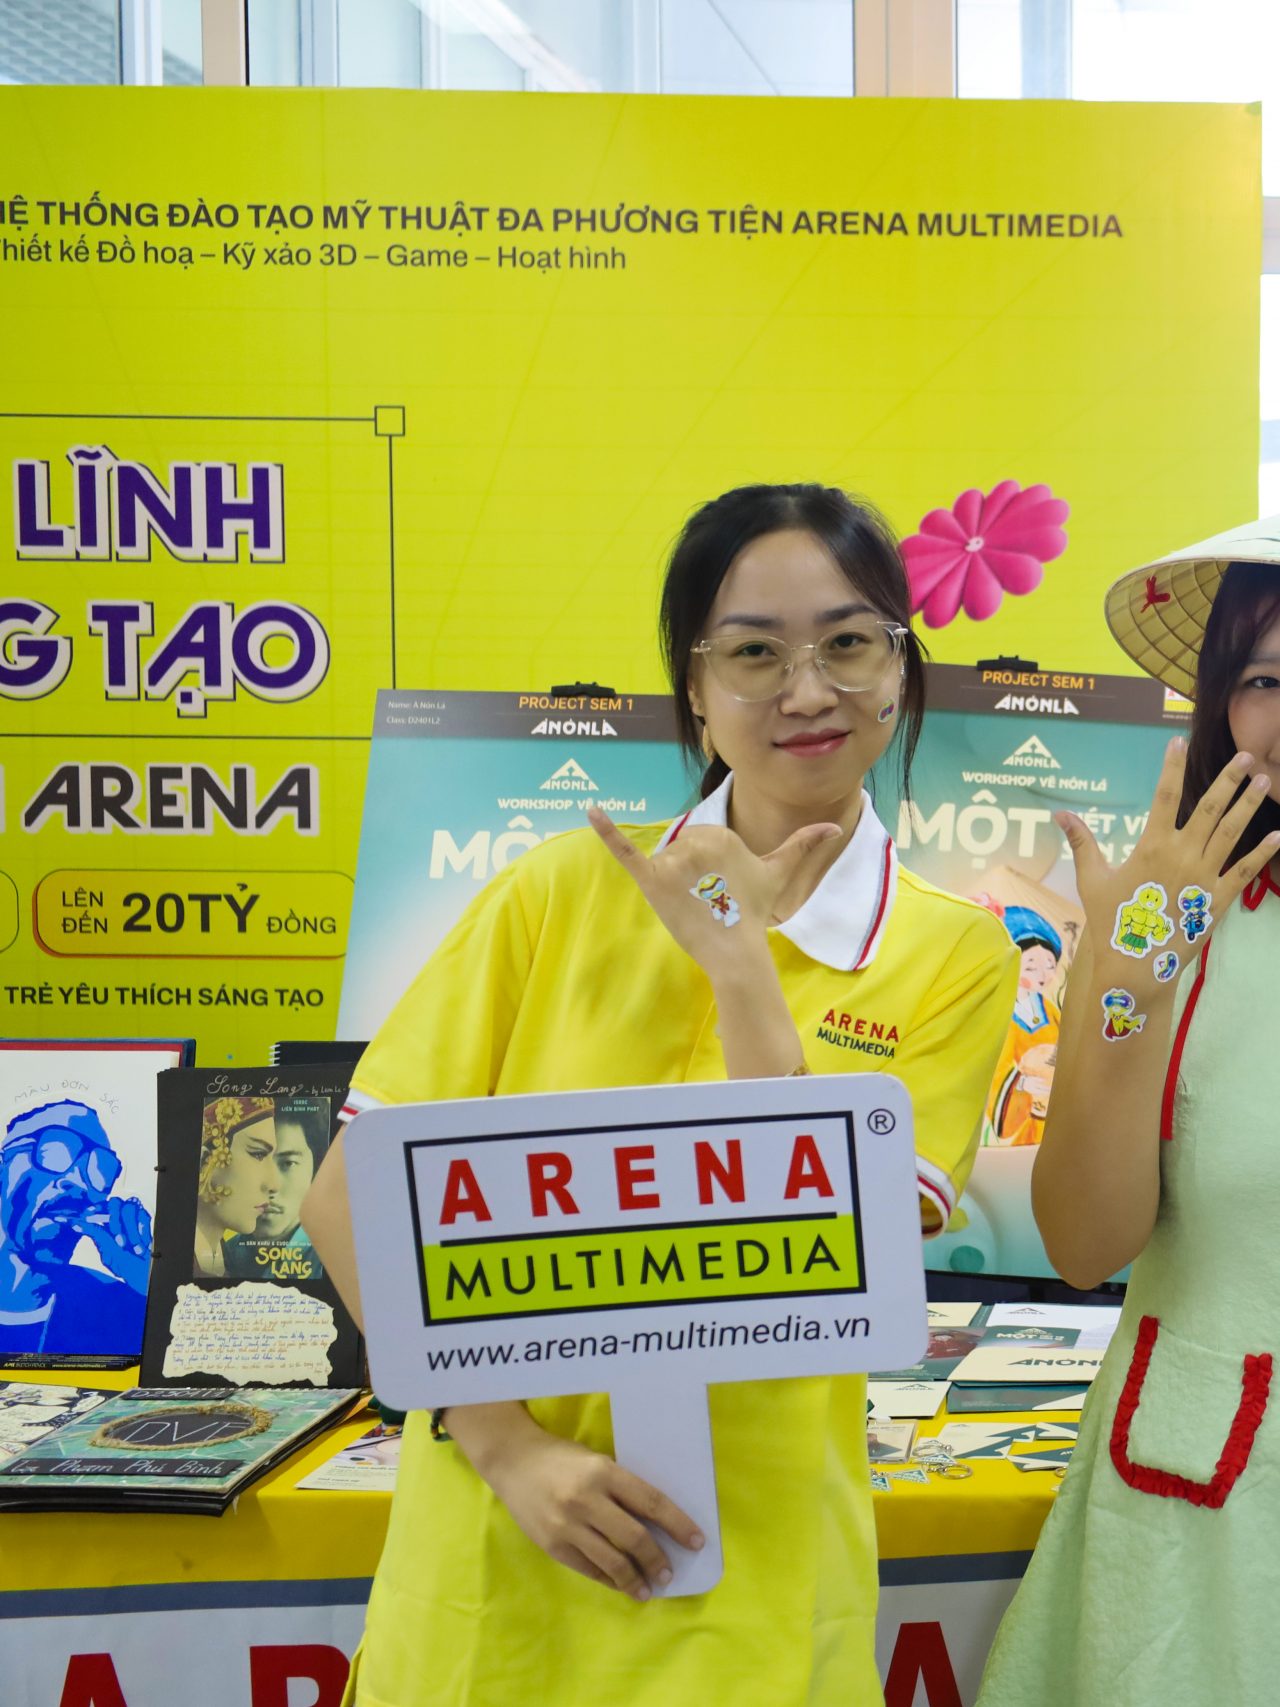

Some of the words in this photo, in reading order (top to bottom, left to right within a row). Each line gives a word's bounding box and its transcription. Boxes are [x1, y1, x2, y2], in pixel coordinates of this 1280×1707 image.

[0, 194, 28, 231] Ệ
[37, 192, 159, 227] THỐNG
[167, 198, 240, 228] ĐÀO
[247, 203, 314, 235] TẠO
[323, 199, 372, 230] MỸ
[379, 201, 490, 237] THUẬT
[496, 207, 544, 232] ĐA
[553, 203, 699, 234] PHƯƠNG
[707, 205, 783, 240] TIỆN
[792, 210, 909, 237] ARENA
[918, 212, 1124, 239] MULTIMEDIA
[0, 232, 52, 262] hiết
[60, 234, 90, 263] kế
[97, 235, 136, 263] Đồ
[144, 242, 194, 270] hoạ
[224, 241, 256, 271] Kỹ
[264, 242, 312, 266] xảo
[319, 243, 357, 266] 3D
[386, 244, 468, 268] Game
[498, 246, 561, 274] Hoạt
[569, 246, 627, 269] hình
[13, 445, 285, 564] LĨNH
[87, 600, 331, 718] TẠO
[982, 671, 1049, 687] PROJECT
[1052, 674, 1083, 689] SEM
[1088, 677, 1095, 690] 1
[519, 696, 587, 710] PROJECT
[590, 697, 622, 711] SEM
[627, 698, 633, 711] 1
[962, 771, 1036, 787] WORKSHOP
[22, 761, 320, 836] ARENA
[497, 798, 574, 811] WORKSHOP
[897, 789, 1051, 870] MỘT
[62, 887, 104, 908] LÊN
[62, 911, 109, 934] ĐẾN
[266, 909, 337, 935] ĐỒNG
[59, 983, 109, 1006] YÊU
[115, 984, 192, 1006] THÍCH
[198, 984, 268, 1007] SÁNG
[276, 988, 324, 1012] TẠO
[822, 1009, 900, 1043] ARENA
[816, 1027, 895, 1059] MULTIMEDIA
[439, 1134, 835, 1226] ARENA
[255, 1247, 303, 1265] SONG
[271, 1261, 313, 1279] LANG
[445, 1234, 841, 1301] MULTIMEDIA
[426, 1315, 872, 1372] www.arena-multimedia.vn
